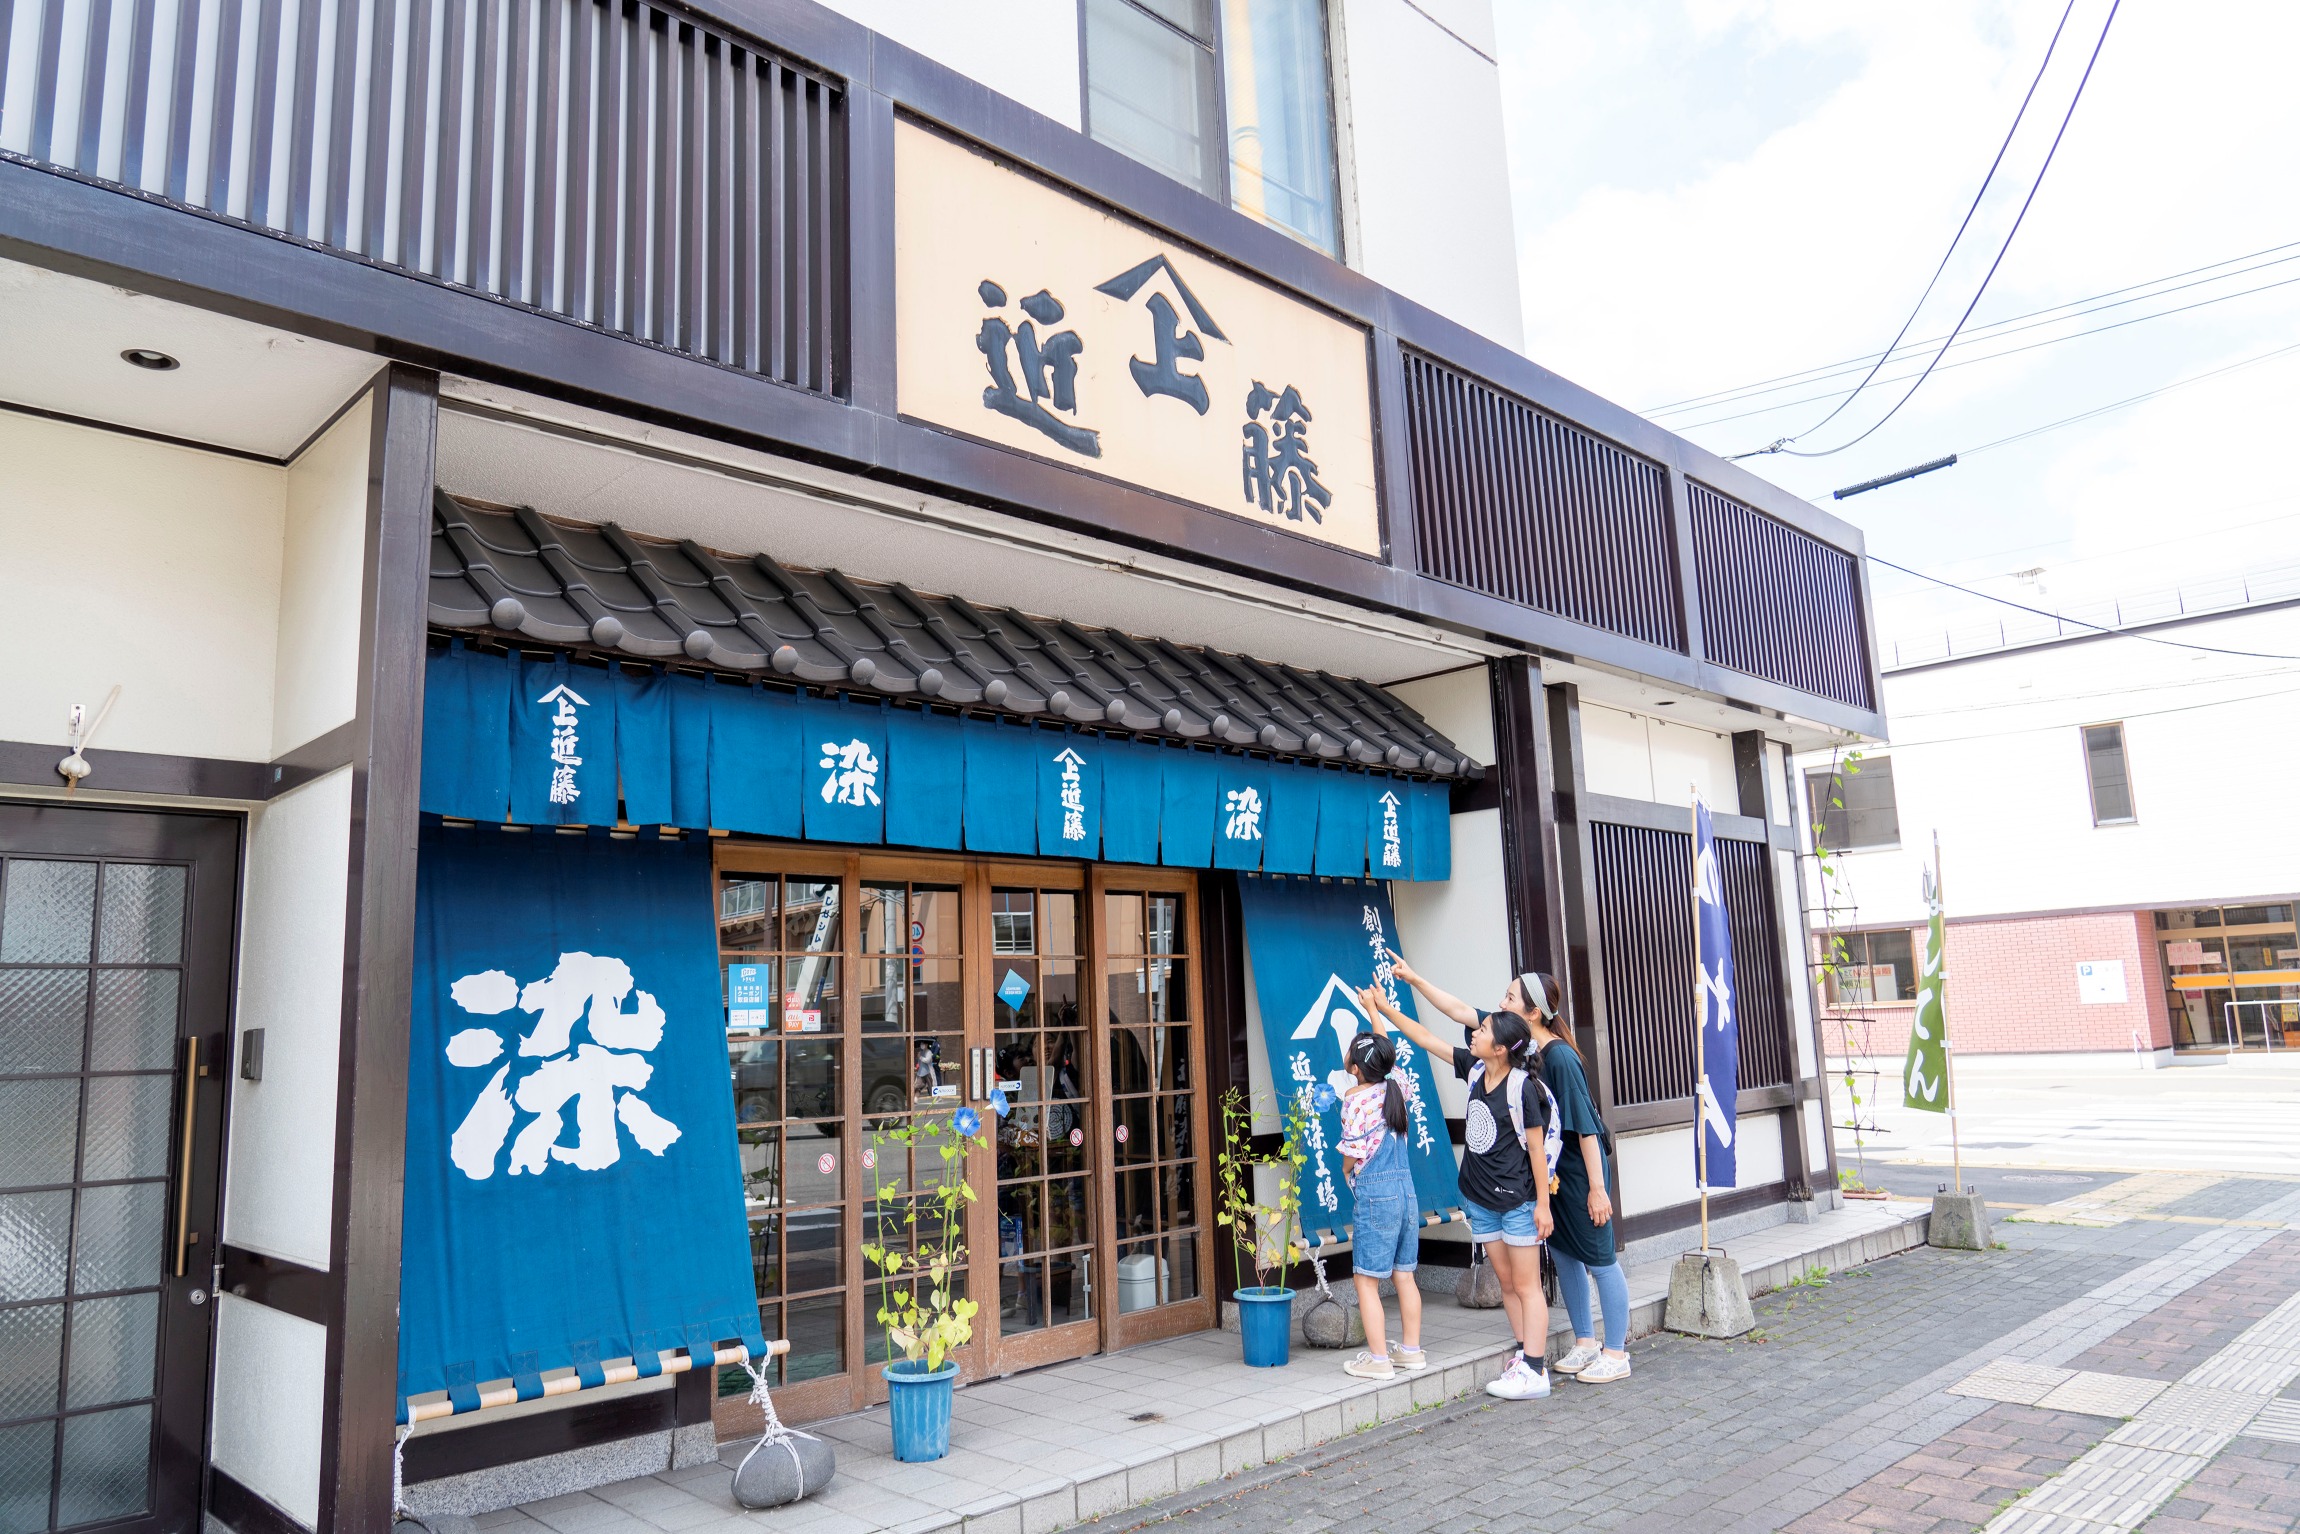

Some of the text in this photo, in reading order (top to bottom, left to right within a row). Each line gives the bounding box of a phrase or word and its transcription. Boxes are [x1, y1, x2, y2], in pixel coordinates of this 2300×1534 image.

[819, 738, 881, 807] 染
[1225, 786, 1262, 841] 染
[445, 951, 683, 1181] 染
